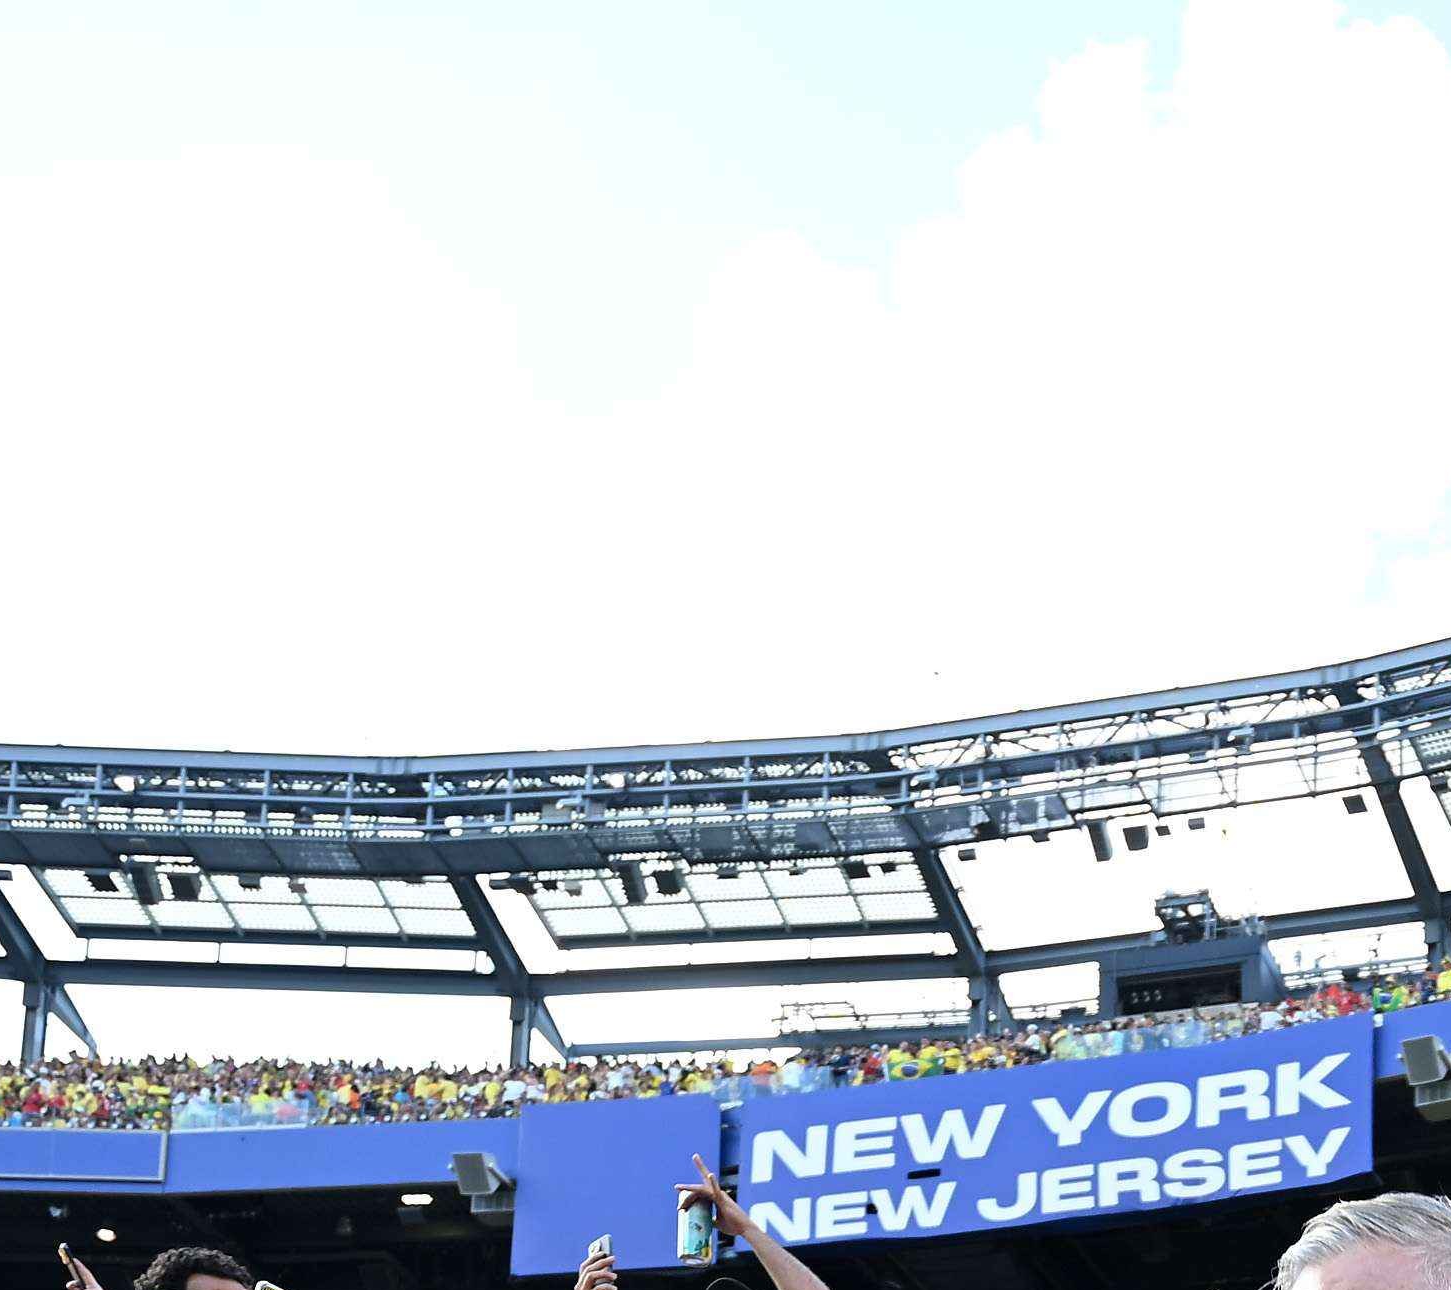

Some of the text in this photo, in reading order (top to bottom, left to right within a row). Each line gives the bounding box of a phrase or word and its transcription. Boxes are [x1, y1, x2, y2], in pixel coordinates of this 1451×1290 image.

[750, 1052, 1352, 1184] NEW YORK
[749, 1127, 1351, 1242] NEW JERSEY
